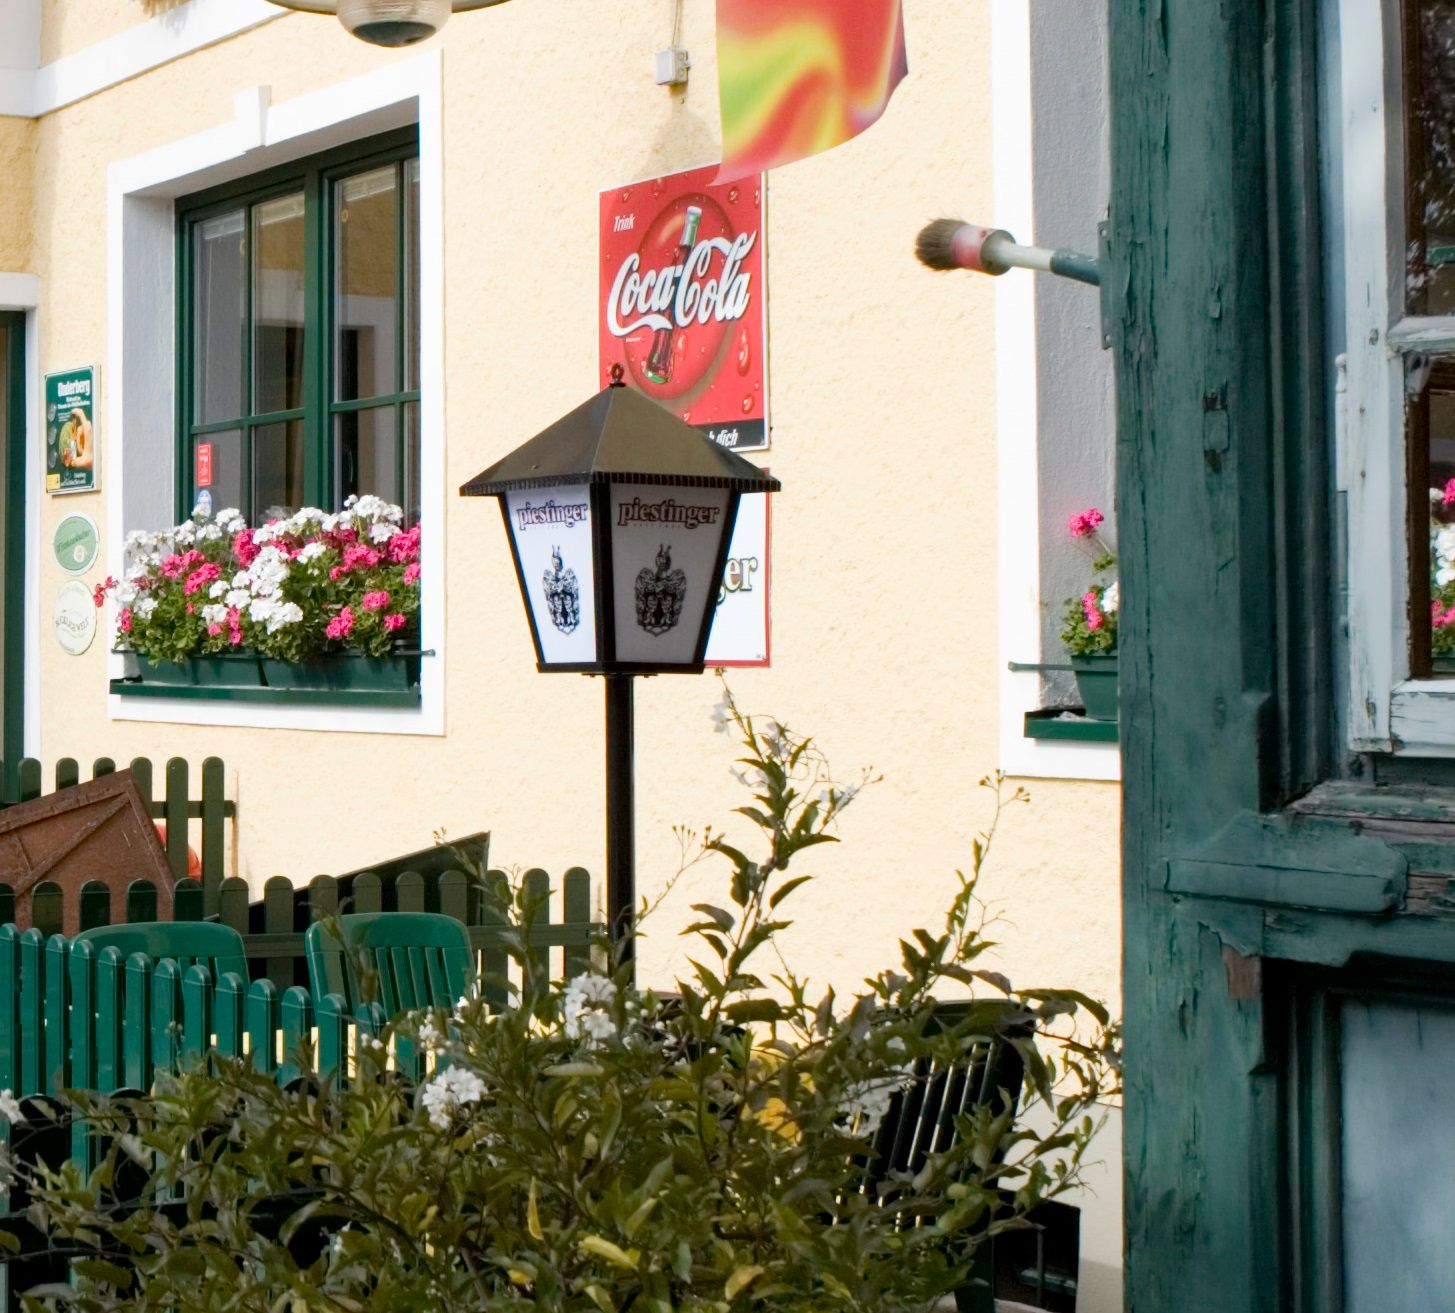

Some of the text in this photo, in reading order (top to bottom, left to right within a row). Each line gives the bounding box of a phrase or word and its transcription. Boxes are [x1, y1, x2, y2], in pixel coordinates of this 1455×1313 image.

[613, 213, 636, 232] Trink
[607, 229, 757, 337] Coca-Cola
[716, 428, 738, 447] dich
[517, 499, 588, 531] piestinger
[618, 497, 719, 530] piestinger
